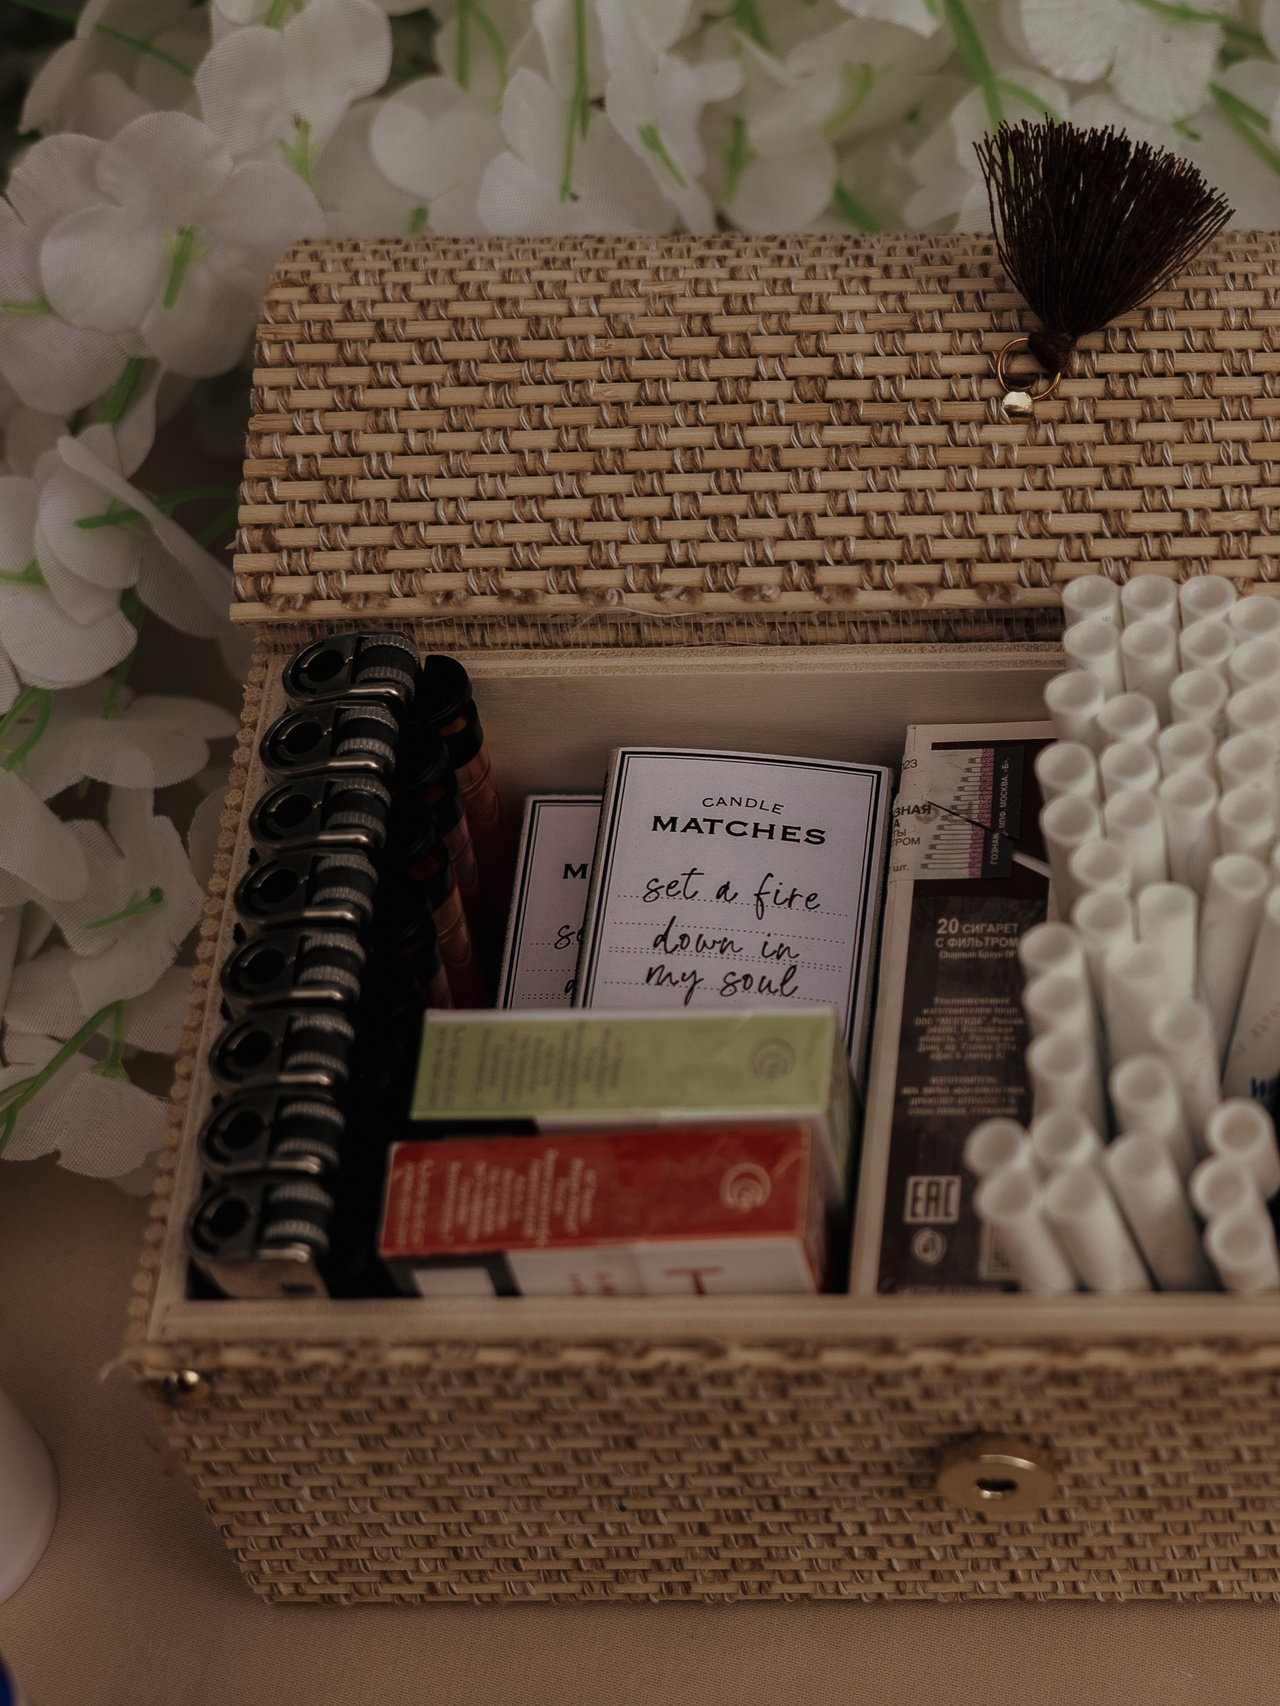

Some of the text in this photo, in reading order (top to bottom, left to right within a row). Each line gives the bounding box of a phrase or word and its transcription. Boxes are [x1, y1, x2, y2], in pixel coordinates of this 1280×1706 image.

[903, 759, 918, 770] 23
[702, 796, 784, 815] CANDLE
[651, 815, 827, 846] MATCHES
[643, 867, 821, 920] set a fire
[653, 916, 800, 961] down in
[937, 918, 1020, 935] 20 СИГАРЕТ
[946, 936, 1019, 948] ФИЛЬТРОМ
[646, 964, 799, 1006] my soul
